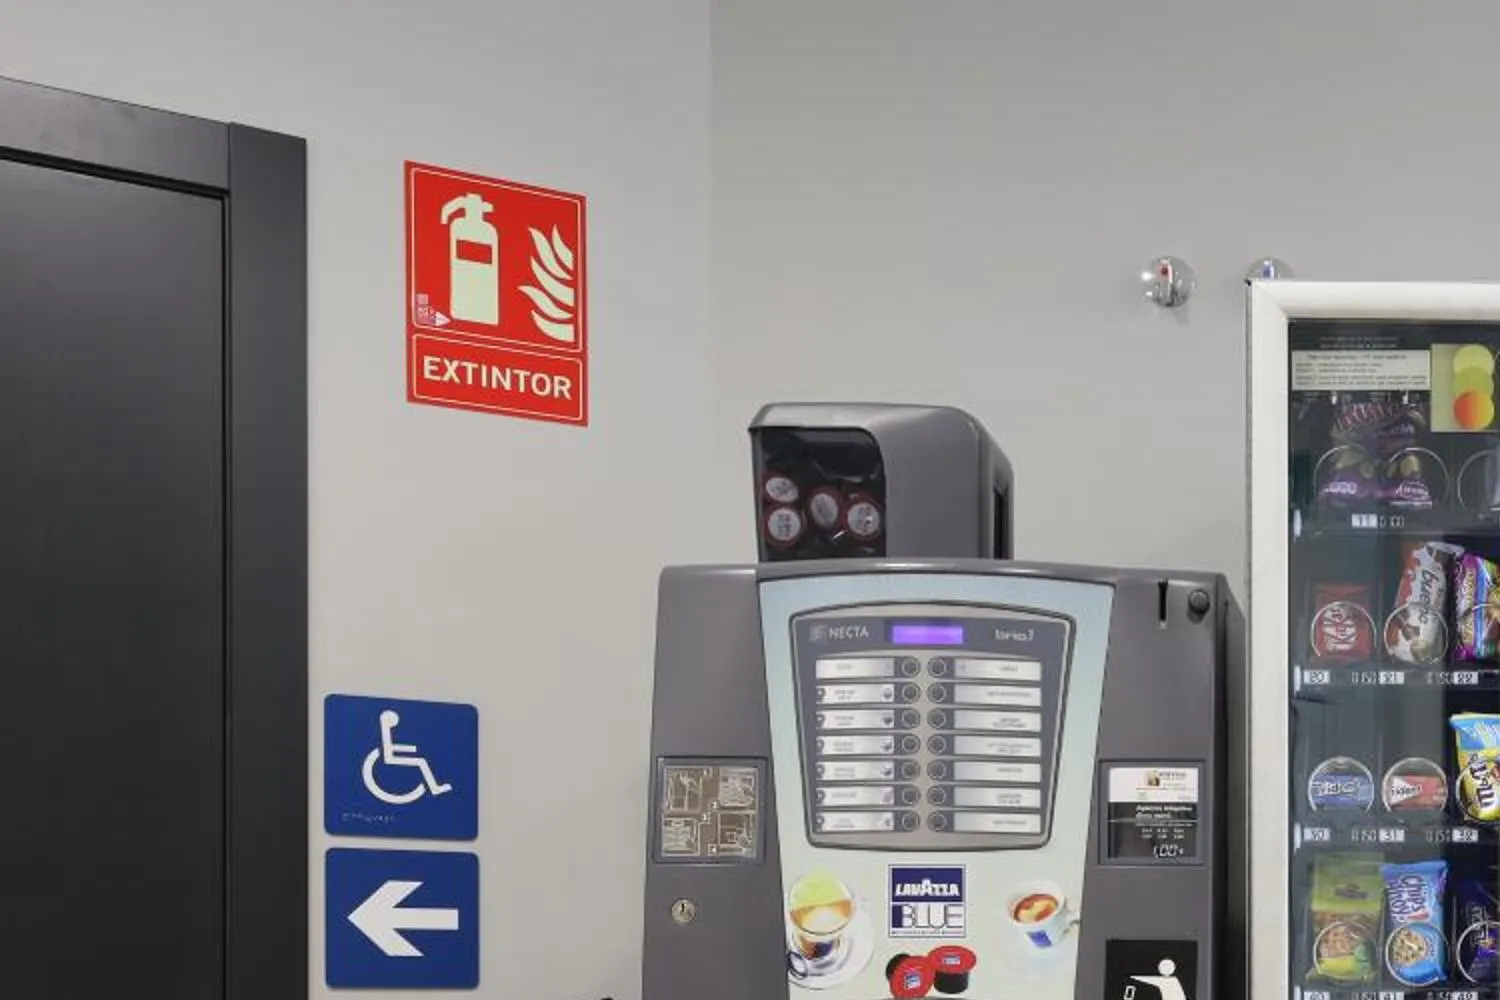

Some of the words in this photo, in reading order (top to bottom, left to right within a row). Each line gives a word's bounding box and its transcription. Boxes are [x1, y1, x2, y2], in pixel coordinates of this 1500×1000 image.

[423, 355, 572, 400] EXTINTOR
[895, 878, 960, 896] LAVAZZA
[892, 903, 964, 928] BLUE
